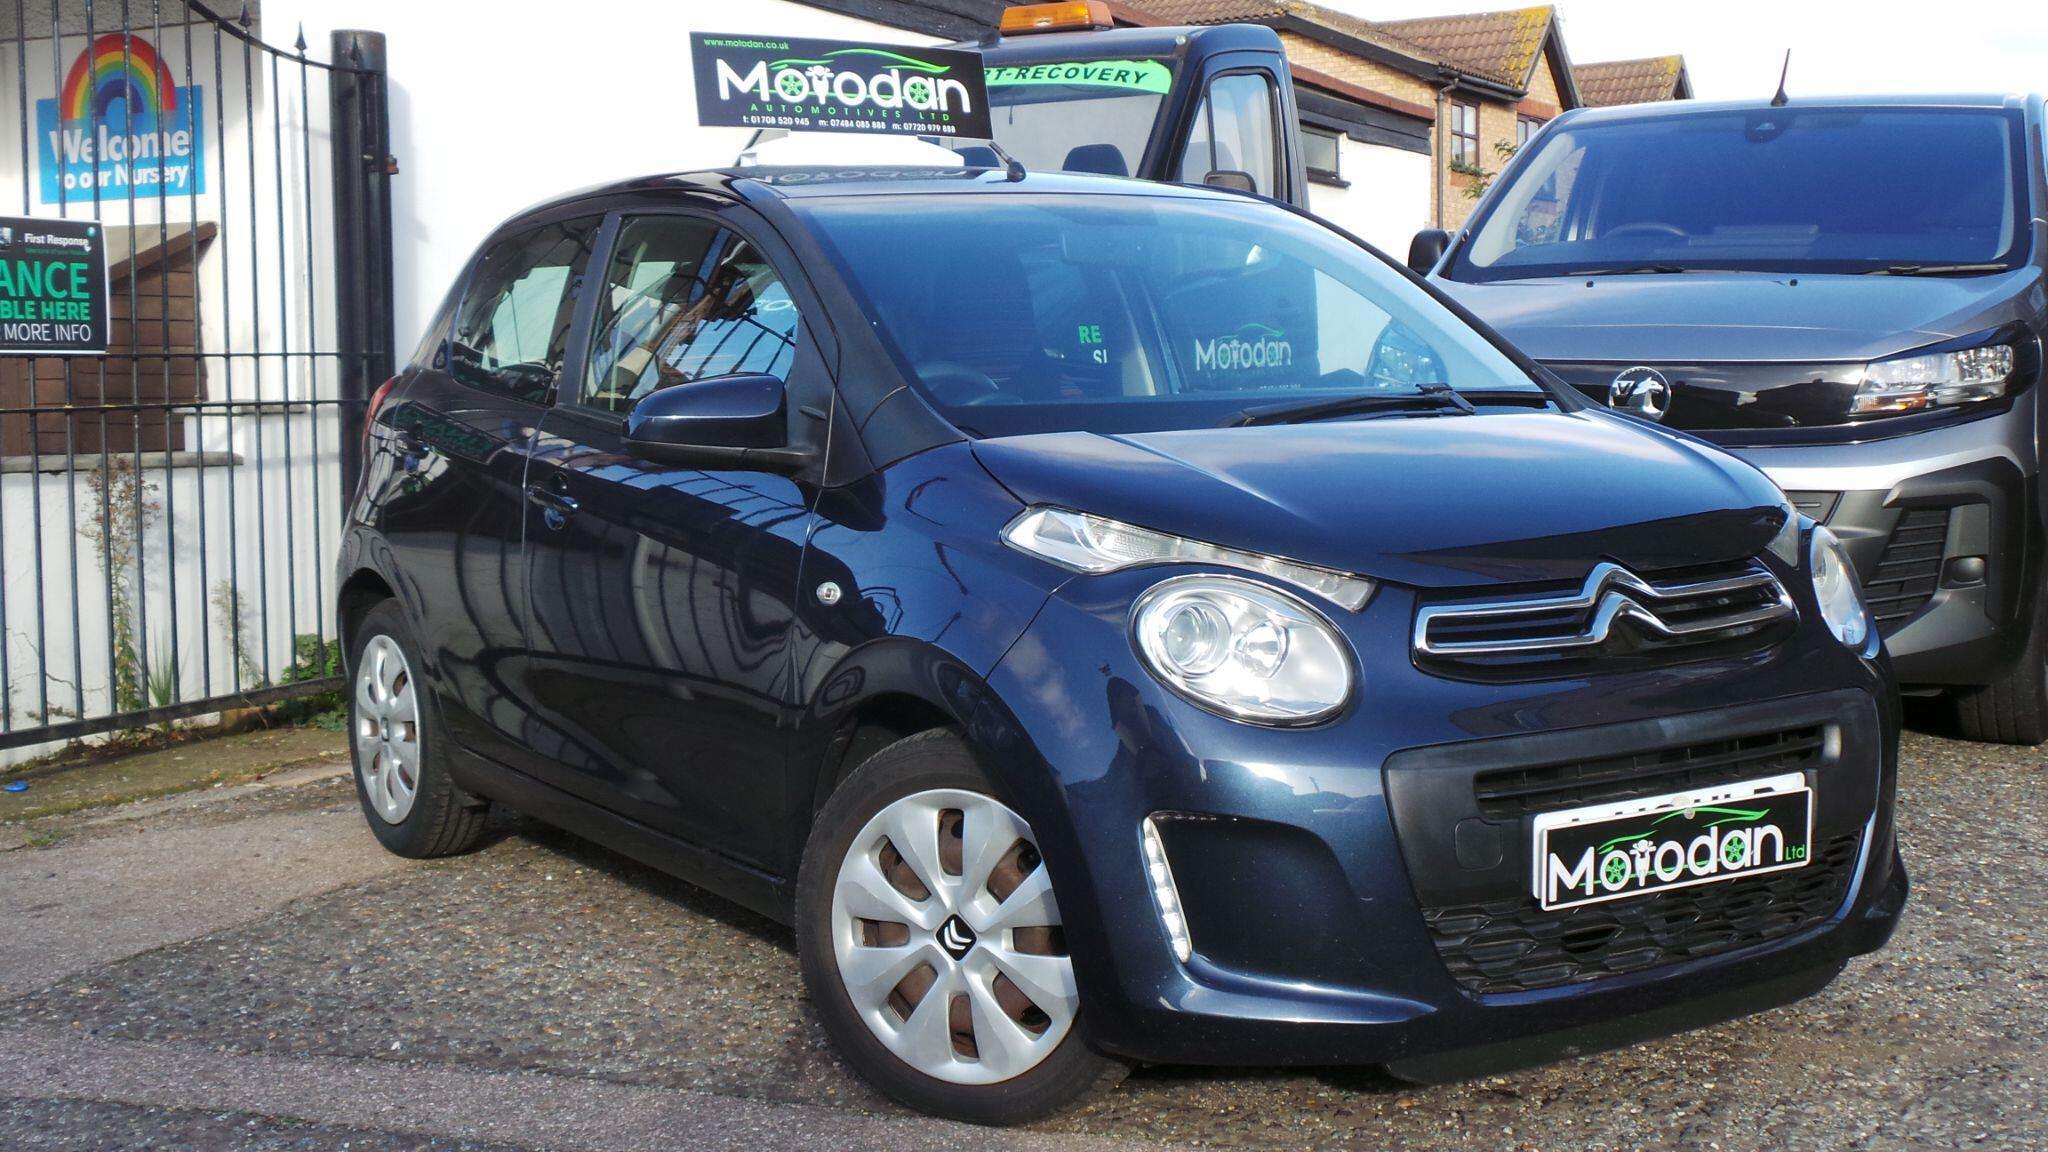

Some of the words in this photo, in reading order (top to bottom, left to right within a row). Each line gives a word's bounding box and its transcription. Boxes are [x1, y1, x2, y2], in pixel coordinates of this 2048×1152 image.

[703, 39, 789, 50] www.motodan.co.uk
[715, 58, 972, 114] Motodan
[750, 103, 902, 119] AUTOMOTIVES
[919, 112, 950, 121] LTD
[750, 115, 776, 125] 01708
[778, 116, 794, 126] 520
[794, 117, 810, 126] 945
[903, 122, 927, 131] 07720
[49, 125, 190, 164] Welcome
[56, 173, 75, 190] o
[115, 163, 188, 188] Nursery
[24, 232, 46, 244] First
[47, 234, 89, 247] Response
[41, 301, 91, 321] HERE
[4, 323, 52, 341] MORE
[55, 324, 91, 342] INFO
[1549, 824, 1784, 902] Motodan
[1785, 843, 1806, 861] Ltd
